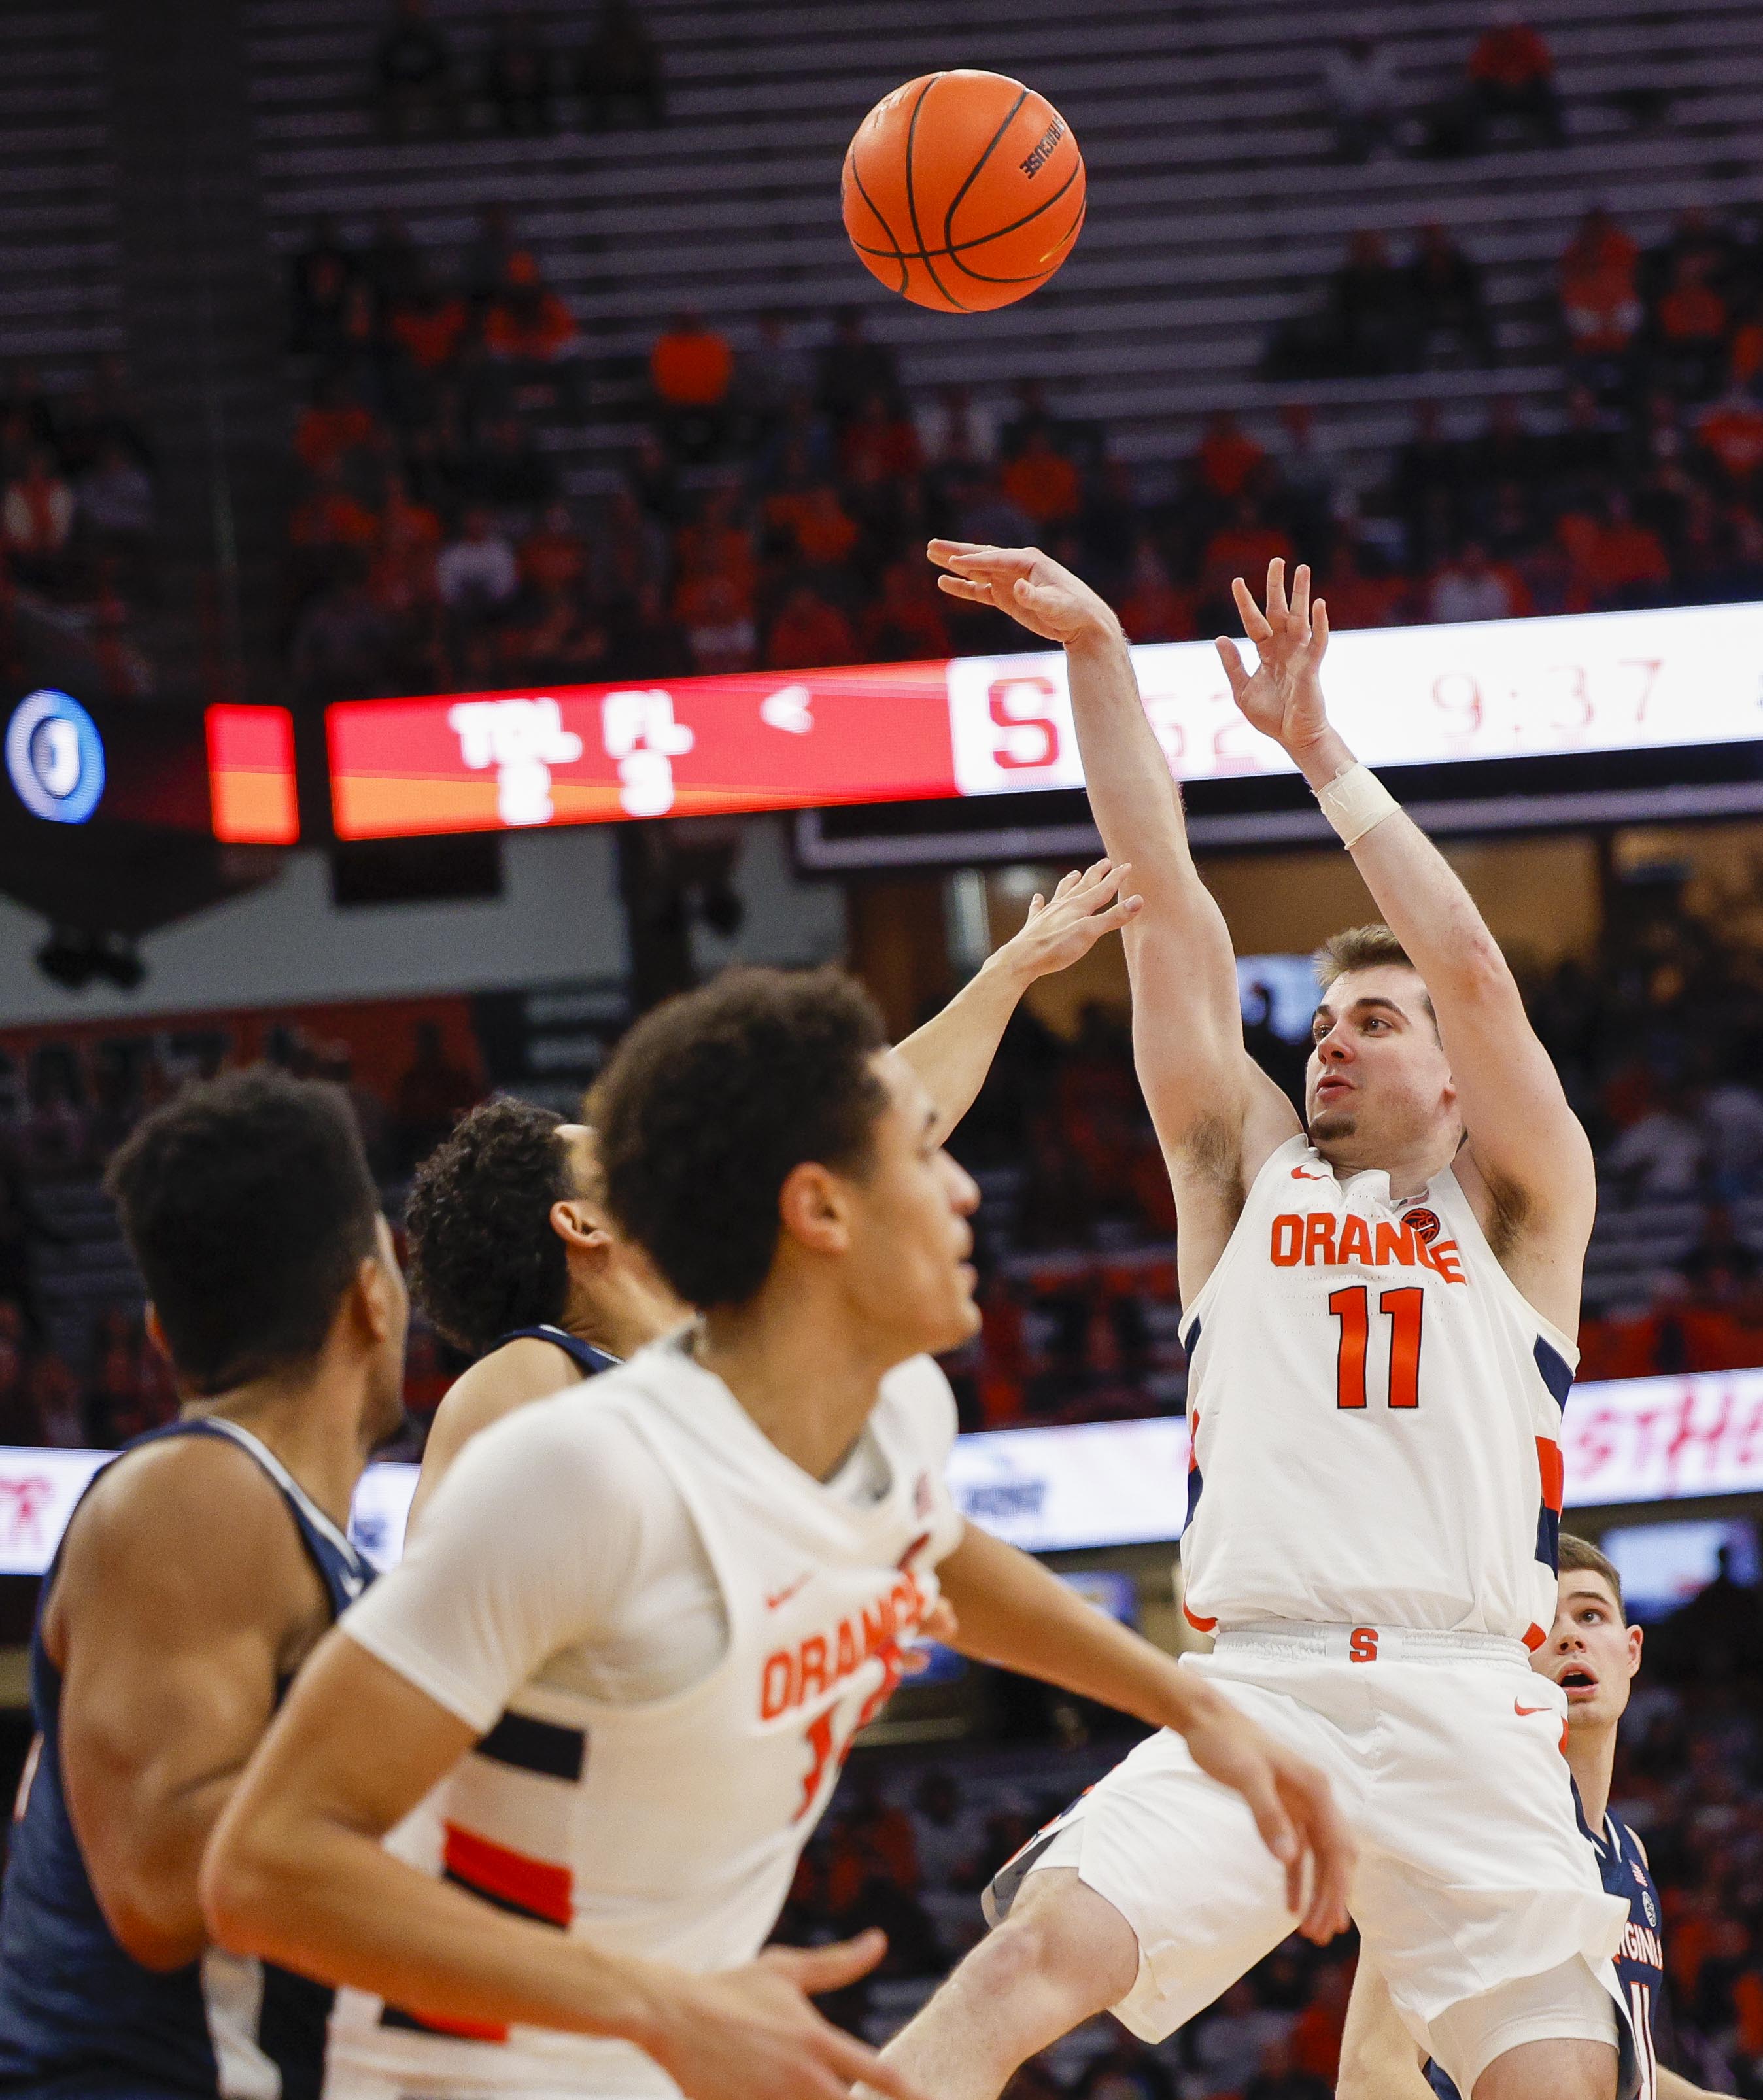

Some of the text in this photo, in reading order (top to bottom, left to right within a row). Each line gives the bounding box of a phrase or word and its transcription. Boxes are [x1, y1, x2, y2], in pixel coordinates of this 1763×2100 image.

[987, 676, 1059, 770] S
[1431, 657, 1664, 736] 9:37
[1328, 1285, 1424, 1409] 11
[1349, 1628, 1379, 1662] S
